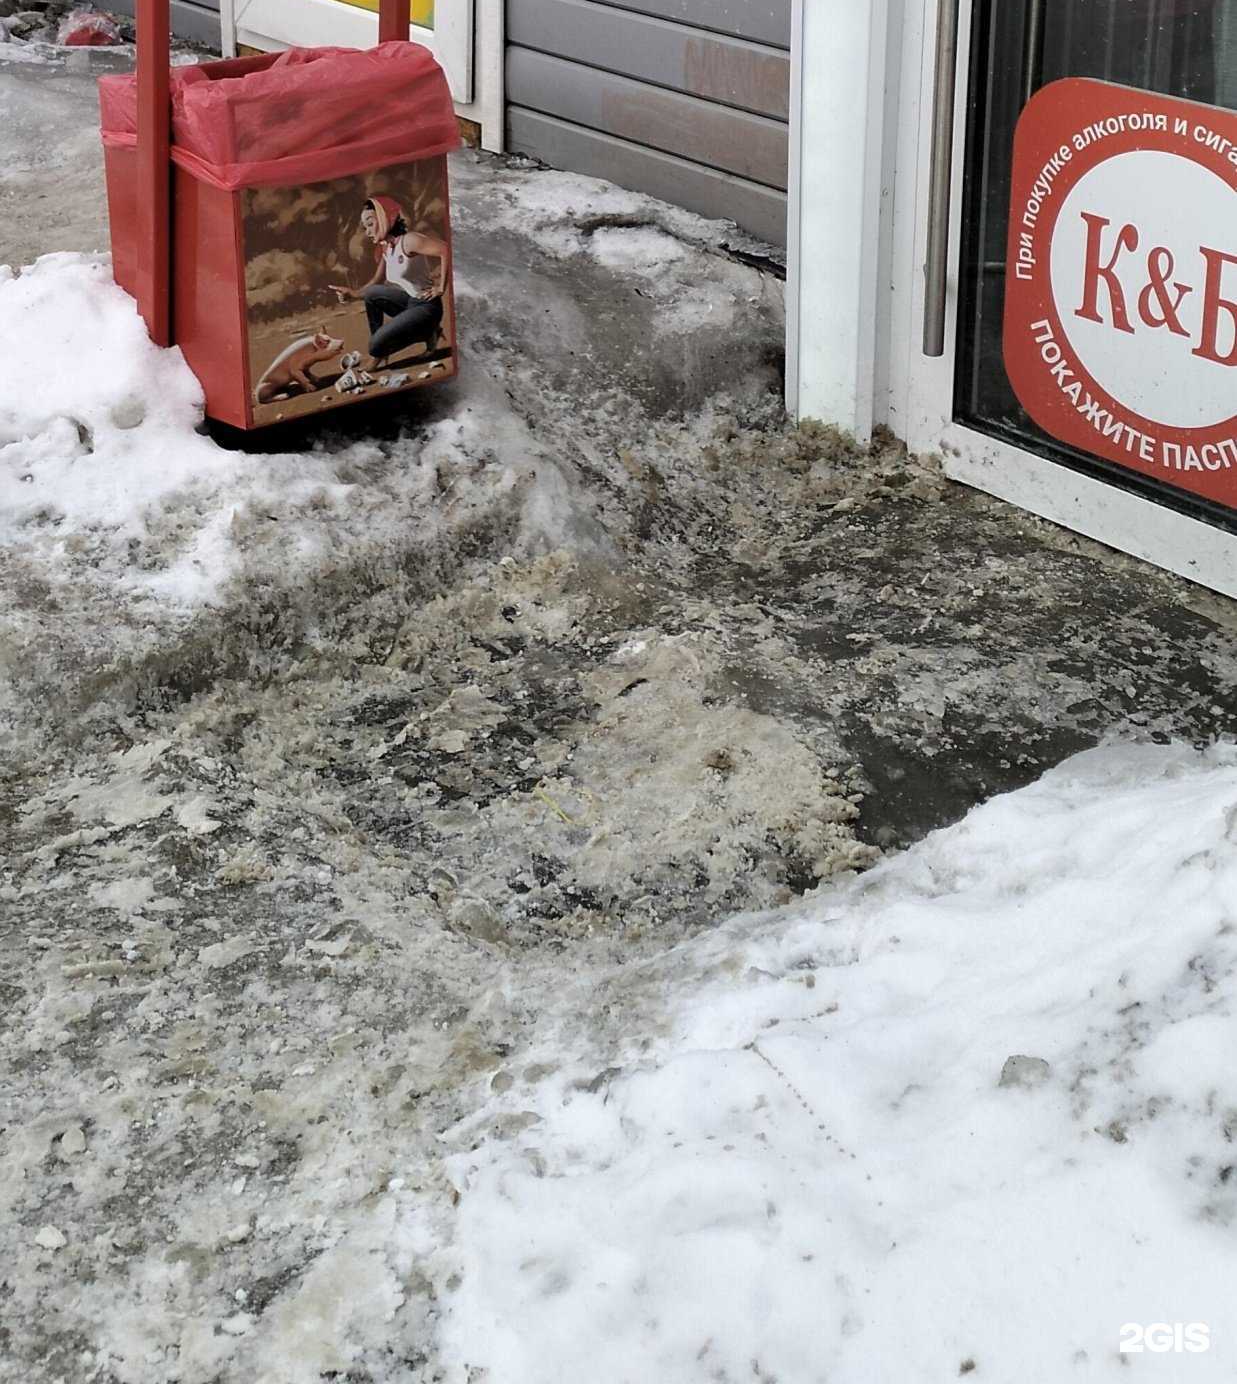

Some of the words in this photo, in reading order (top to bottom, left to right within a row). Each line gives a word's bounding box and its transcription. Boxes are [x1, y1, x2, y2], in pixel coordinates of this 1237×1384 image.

[1072, 113, 1168, 151] алкоголя
[1173, 118, 1188, 136] и
[1022, 145, 1073, 229] покупке
[1016, 233, 1036, 280] При
[1030, 319, 1156, 463] ПОКАЖИТЕ
